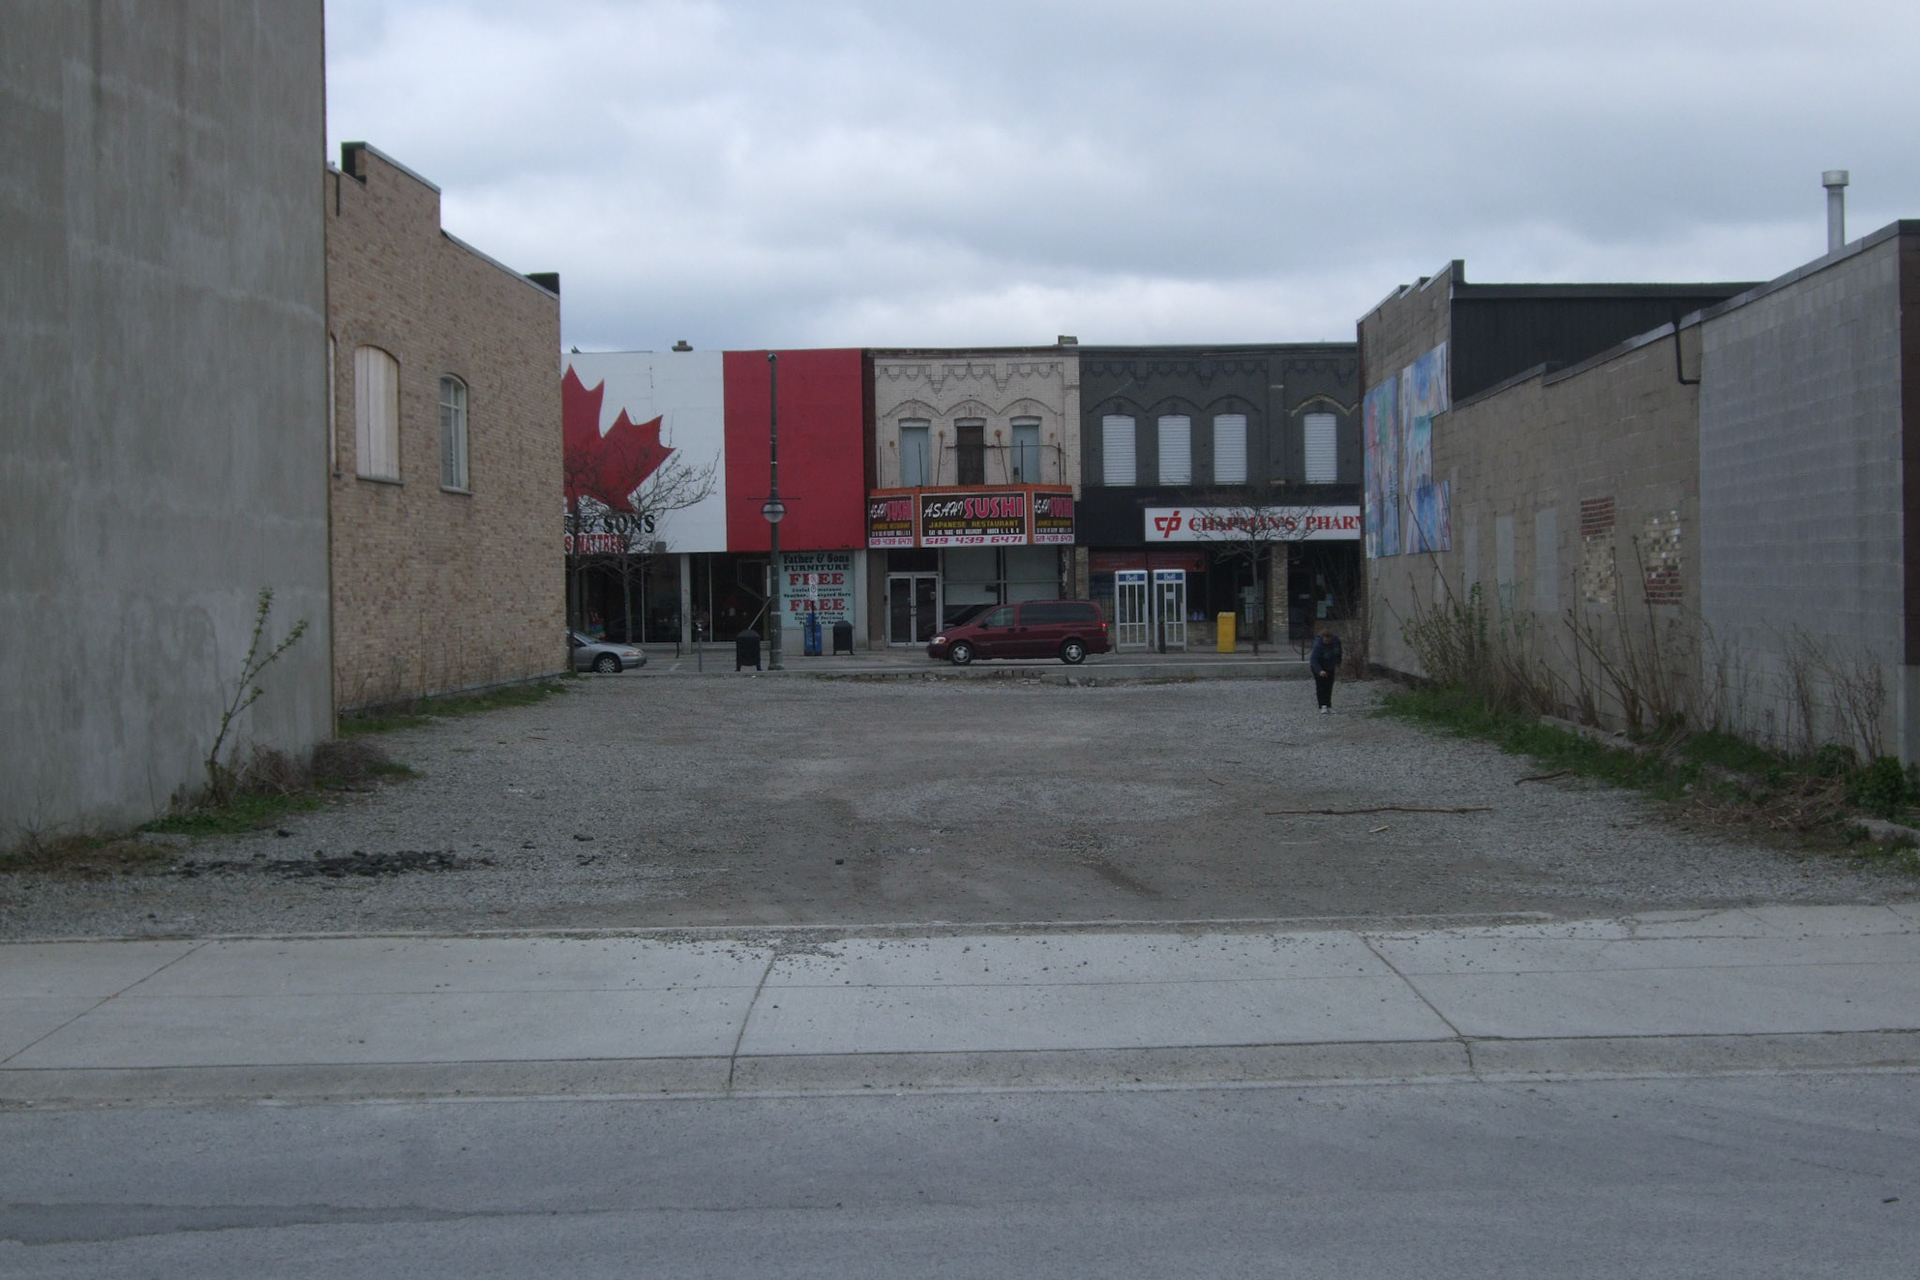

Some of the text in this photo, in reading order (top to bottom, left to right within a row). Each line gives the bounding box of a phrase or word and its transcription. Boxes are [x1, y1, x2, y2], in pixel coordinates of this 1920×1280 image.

[923, 496, 1023, 519] ASAHI SUSHI
[602, 514, 655, 534] SONS
[928, 519, 1019, 529] JAPANESE RESTAURANT
[1188, 515, 1297, 532] CHAPMAN'S
[577, 534, 627, 553] MATTRES
[925, 535, 1023, 545] 519 439 6471
[783, 554, 815, 564] Father
[827, 553, 850, 563] Sons
[784, 563, 850, 572] FURNITURE
[1164, 573, 1176, 581] Bell
